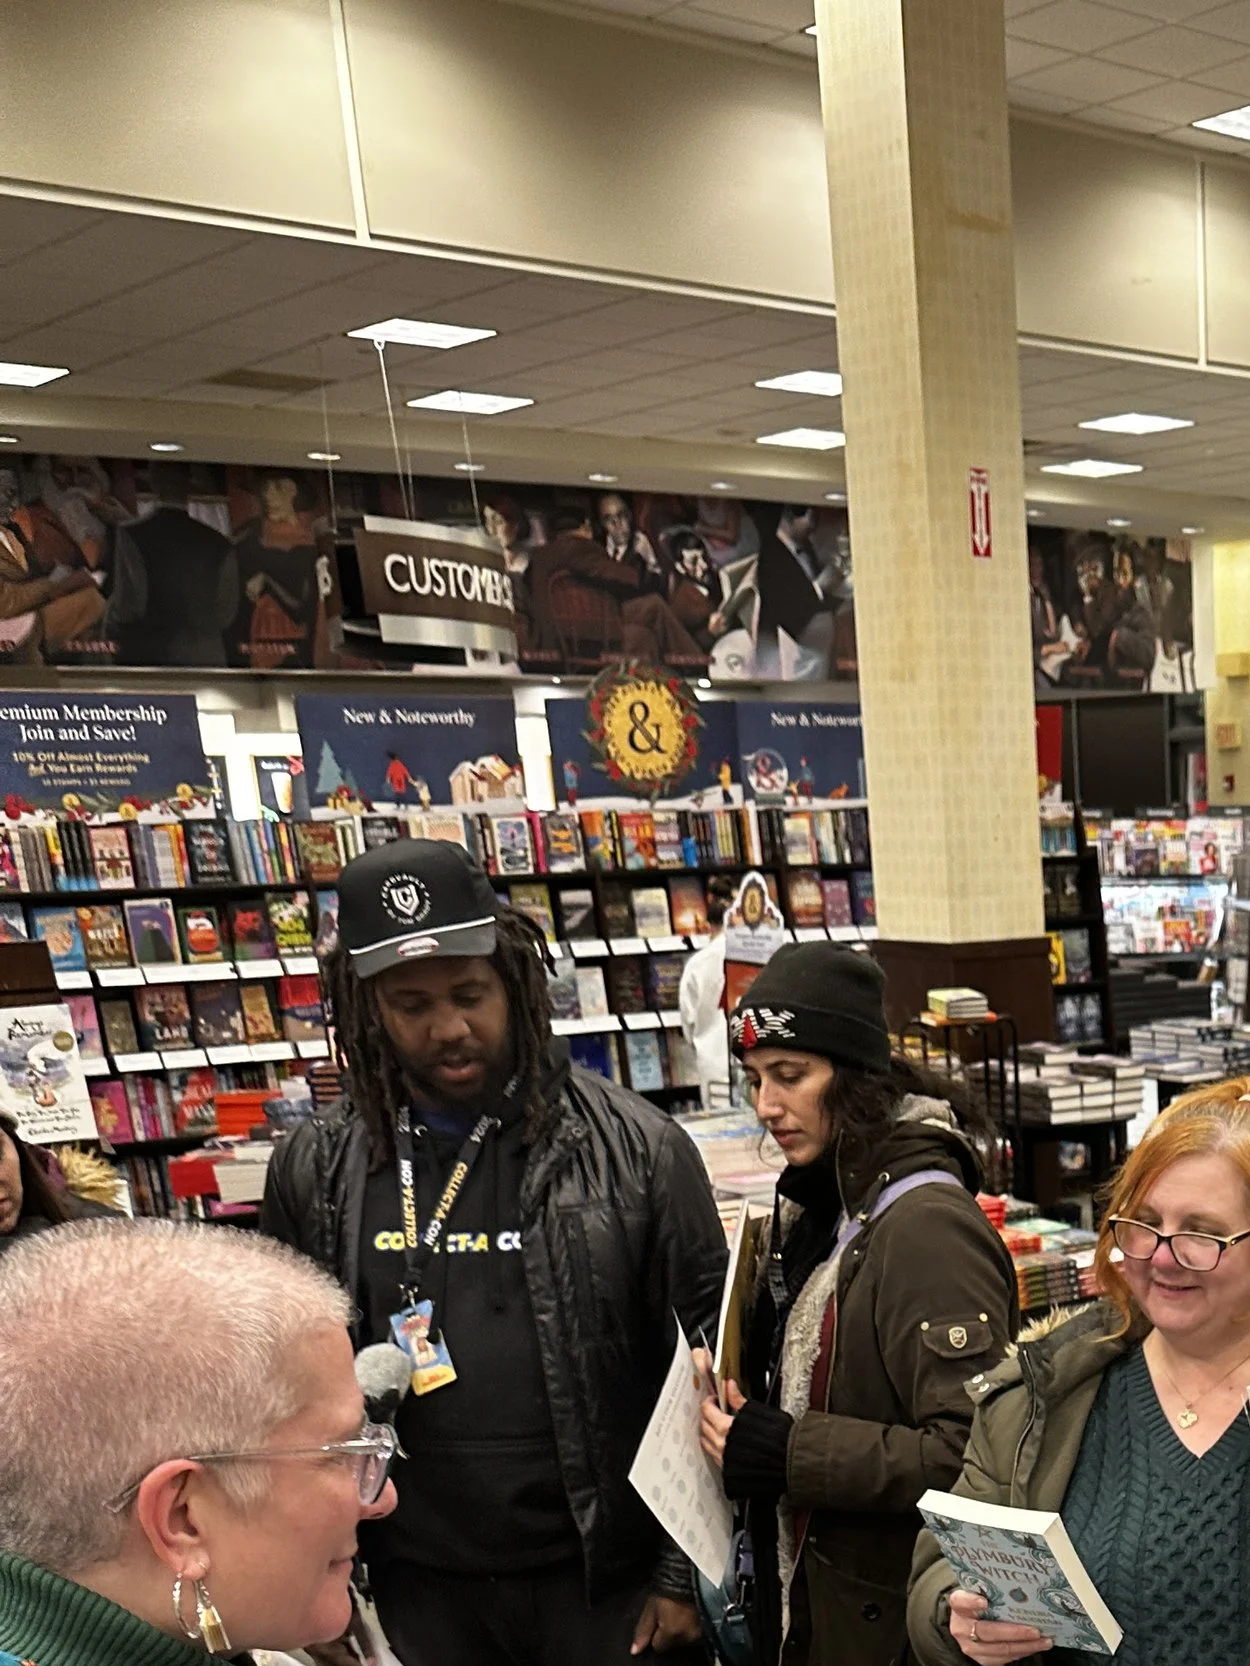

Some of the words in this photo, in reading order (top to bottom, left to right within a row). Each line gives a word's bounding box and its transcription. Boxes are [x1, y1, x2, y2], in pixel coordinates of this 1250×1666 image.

[0, 704, 60, 722] emium
[63, 704, 167, 725] Membership
[344, 709, 375, 725] New
[379, 710, 393, 724] &
[396, 709, 476, 728] Noteworthy
[771, 713, 796, 727] New
[20, 725, 55, 743] Join
[58, 725, 89, 742] and
[94, 725, 137, 742] Save!
[951, 1545, 1054, 1577] PLYMBURY
[971, 1560, 1040, 1586] WITCH
